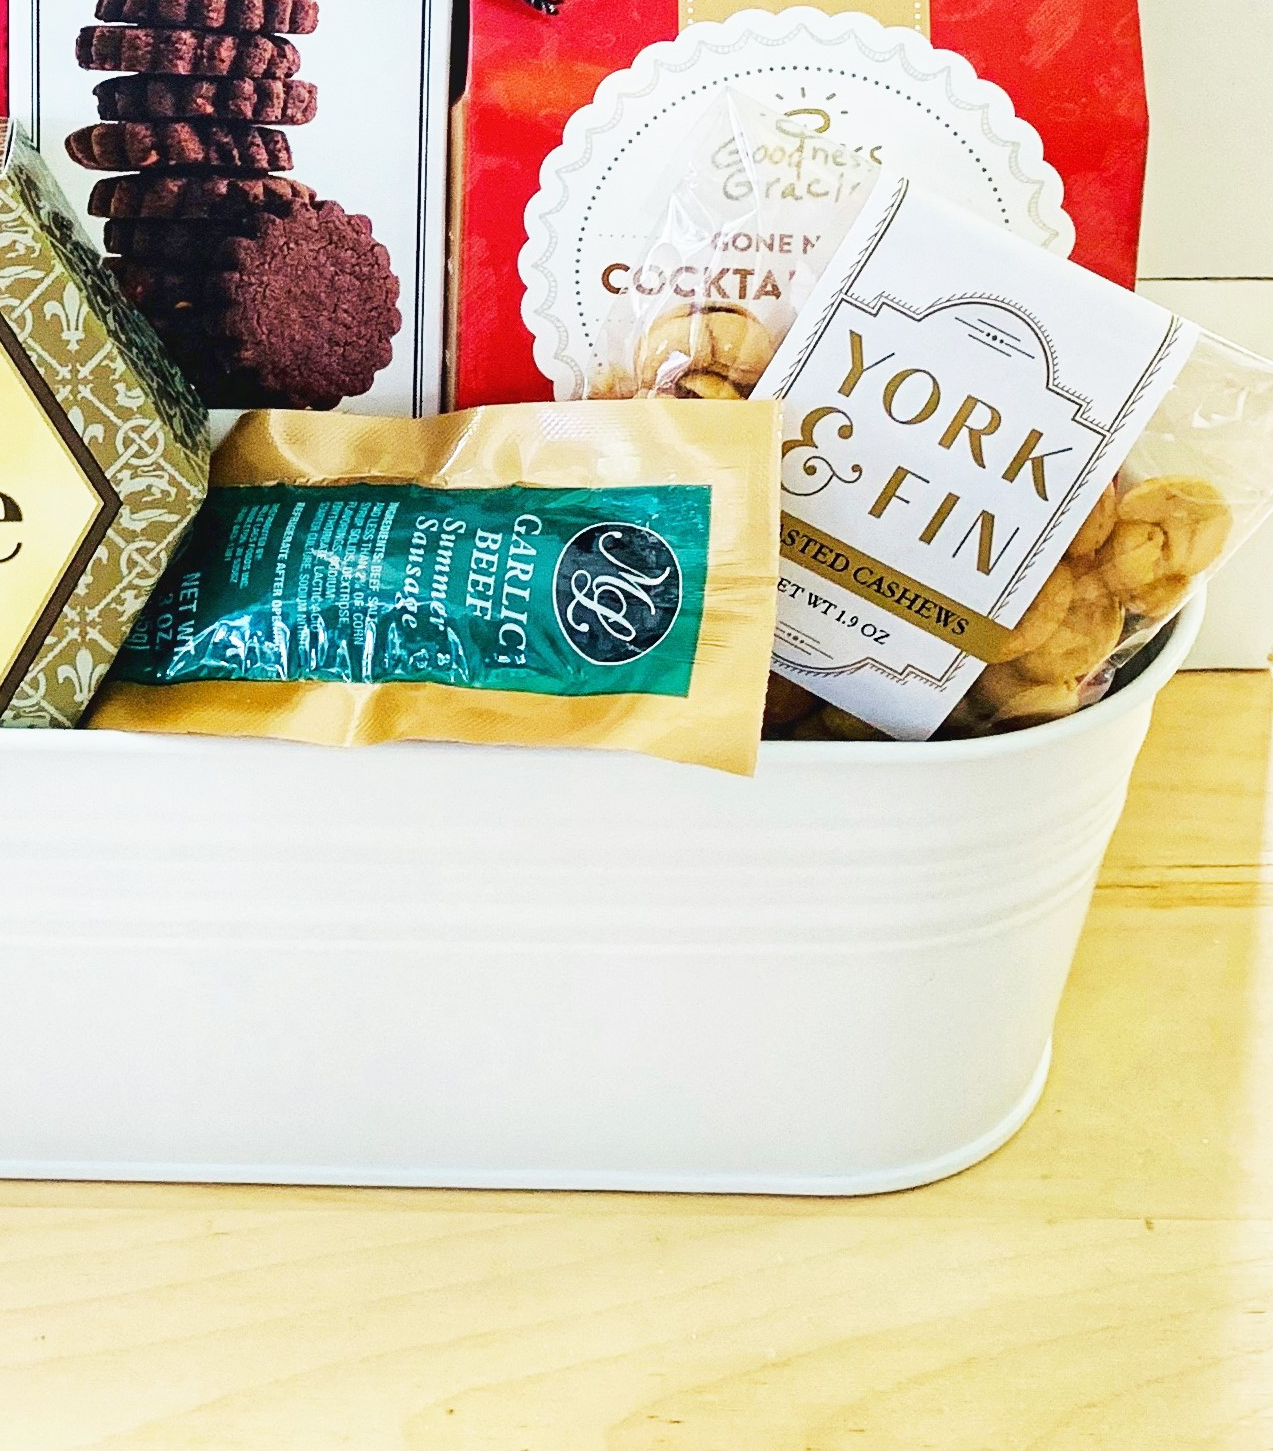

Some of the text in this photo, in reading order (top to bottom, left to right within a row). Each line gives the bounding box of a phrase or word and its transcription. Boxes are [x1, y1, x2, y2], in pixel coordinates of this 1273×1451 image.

[723, 168, 860, 203] Graci
[600, 262, 796, 301] COCKTA
[838, 329, 1073, 502] YORK
[781, 406, 1019, 576] & FIN
[364, 519, 380, 541] LESS
[179, 572, 201, 613] NET
[271, 563, 287, 597] AFTER
[310, 565, 324, 602] LACTIC
[394, 515, 439, 630] Sausage
[429, 517, 467, 632] Summer
[465, 527, 503, 620] BEEF
[498, 514, 543, 652] GARLIC
[853, 566, 970, 636] CASHEWS
[352, 613, 364, 645] CORN
[777, 577, 891, 645] ET WT 1.9 OZ
